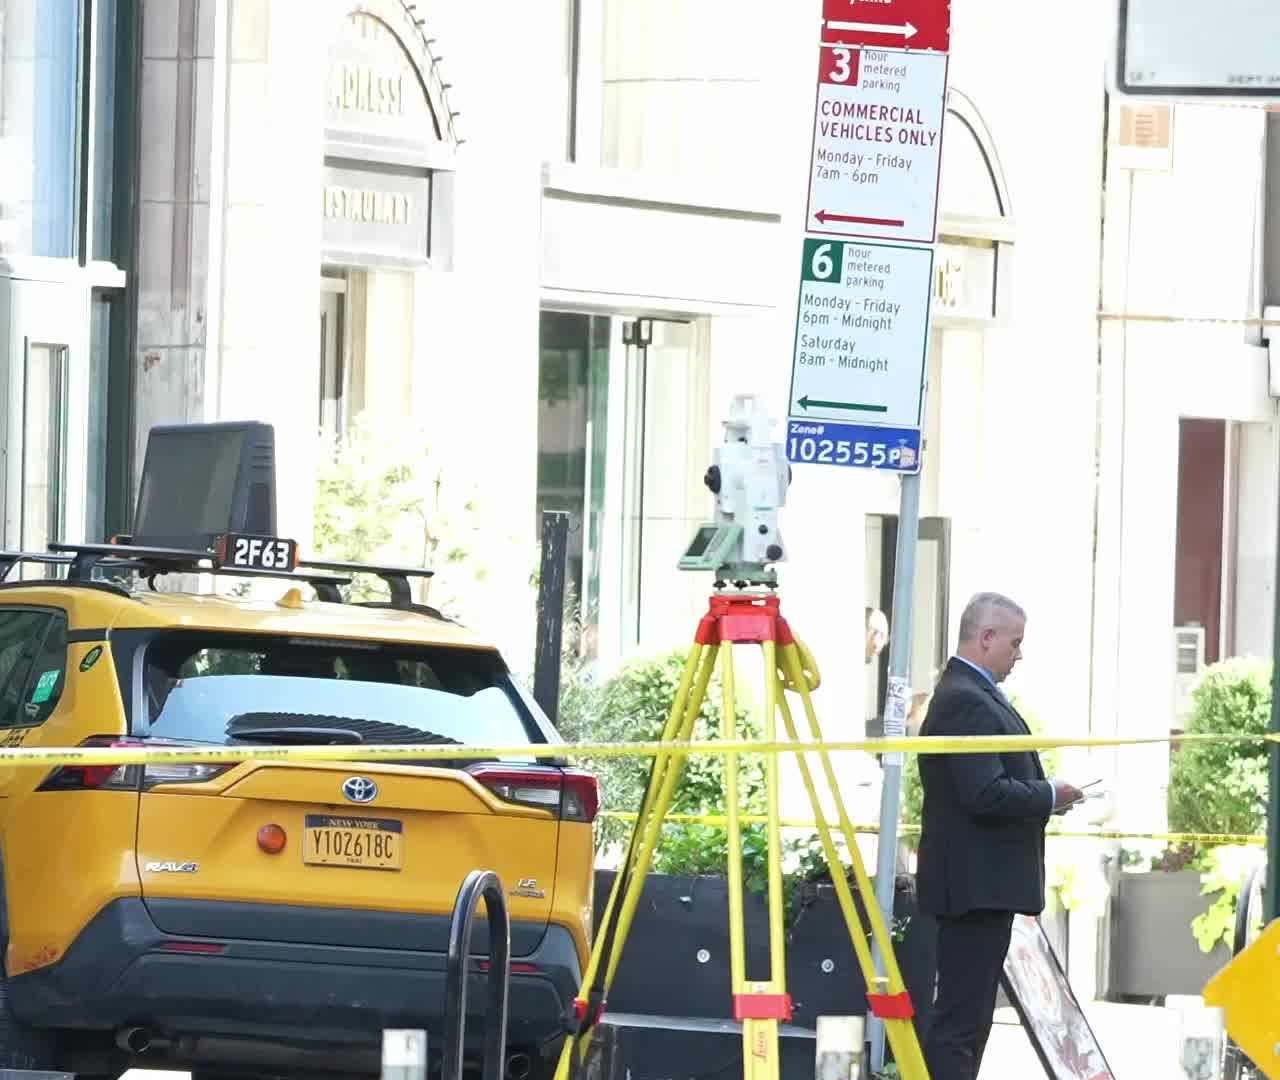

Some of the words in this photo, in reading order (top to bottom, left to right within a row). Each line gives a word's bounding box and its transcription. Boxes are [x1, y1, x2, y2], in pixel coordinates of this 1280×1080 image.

[829, 48, 851, 83] 3
[864, 51, 888, 62] hour
[863, 64, 906, 77] metered
[862, 79, 901, 92] parking
[821, 100, 924, 125] COMMERCIAL
[820, 121, 893, 142] VEHICLES
[898, 129, 937, 146] ONLY
[817, 148, 863, 167] Monday
[876, 153, 913, 170] Friday
[816, 166, 840, 179] 7am
[852, 170, 879, 184] 6pm
[811, 244, 833, 280] 6
[848, 248, 872, 258] hour
[847, 262, 891, 274] metered
[847, 276, 885, 290] parking
[804, 293, 851, 311] Monday
[863, 299, 901, 315] Friday
[803, 310, 829, 326] 6pm
[842, 314, 892, 331] Midnight
[801, 334, 856, 354] Saturday
[799, 352, 826, 366] 8am
[838, 356, 889, 373] Midnight
[790, 424, 825, 436] Zone#
[790, 438, 886, 465] 102555
[233, 538, 291, 569] 2F63
[313, 830, 393, 859] Y102618C
